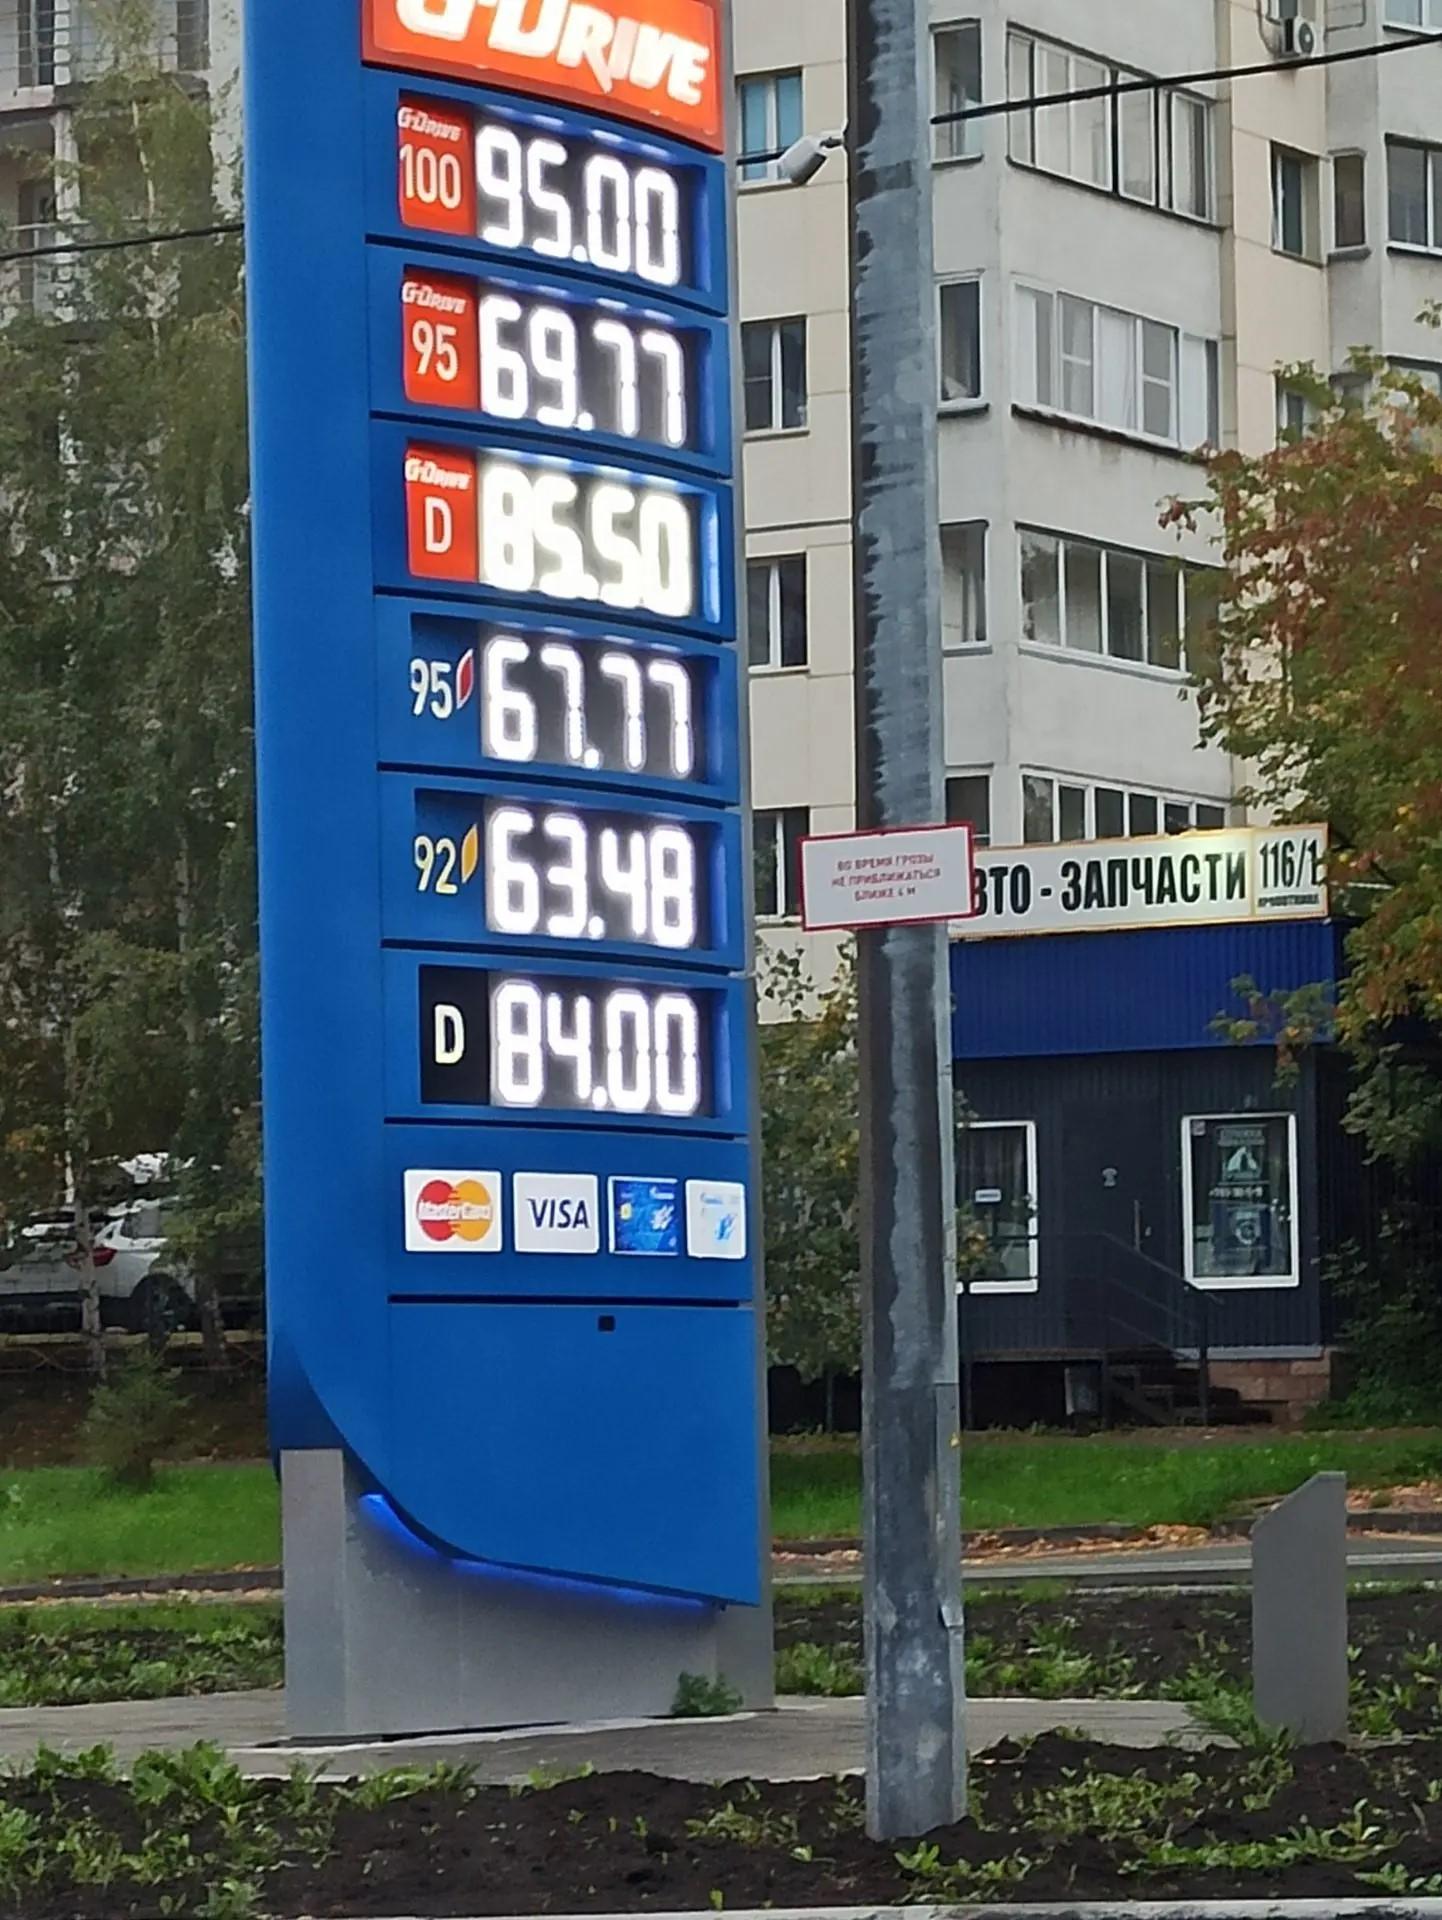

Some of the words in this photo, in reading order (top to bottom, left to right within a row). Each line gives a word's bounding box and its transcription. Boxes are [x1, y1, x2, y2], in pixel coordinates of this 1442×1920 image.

[399, 144, 461, 209] 100
[475, 125, 679, 287] 95.00
[412, 320, 458, 381] 95
[479, 295, 686, 448] 69.77
[424, 496, 452, 553] D
[482, 466, 692, 617] 85.50
[410, 659, 453, 719] 95
[486, 635, 692, 776] 67.77
[414, 836, 458, 894] 92
[491, 807, 695, 947] 63.48
[849, 868, 941, 886] ПРИБЛИЖАТЬСЯ
[855, 857, 892, 870] ВРЕМЯ
[973, 864, 1031, 915] ВТО
[1061, 851, 1246, 911] ЗАПЧАСТИ
[1260, 839, 1317, 888] 116/1
[434, 1004, 465, 1064] D
[497, 980, 698, 1114] 84.00
[528, 1199, 589, 1229] VISA
